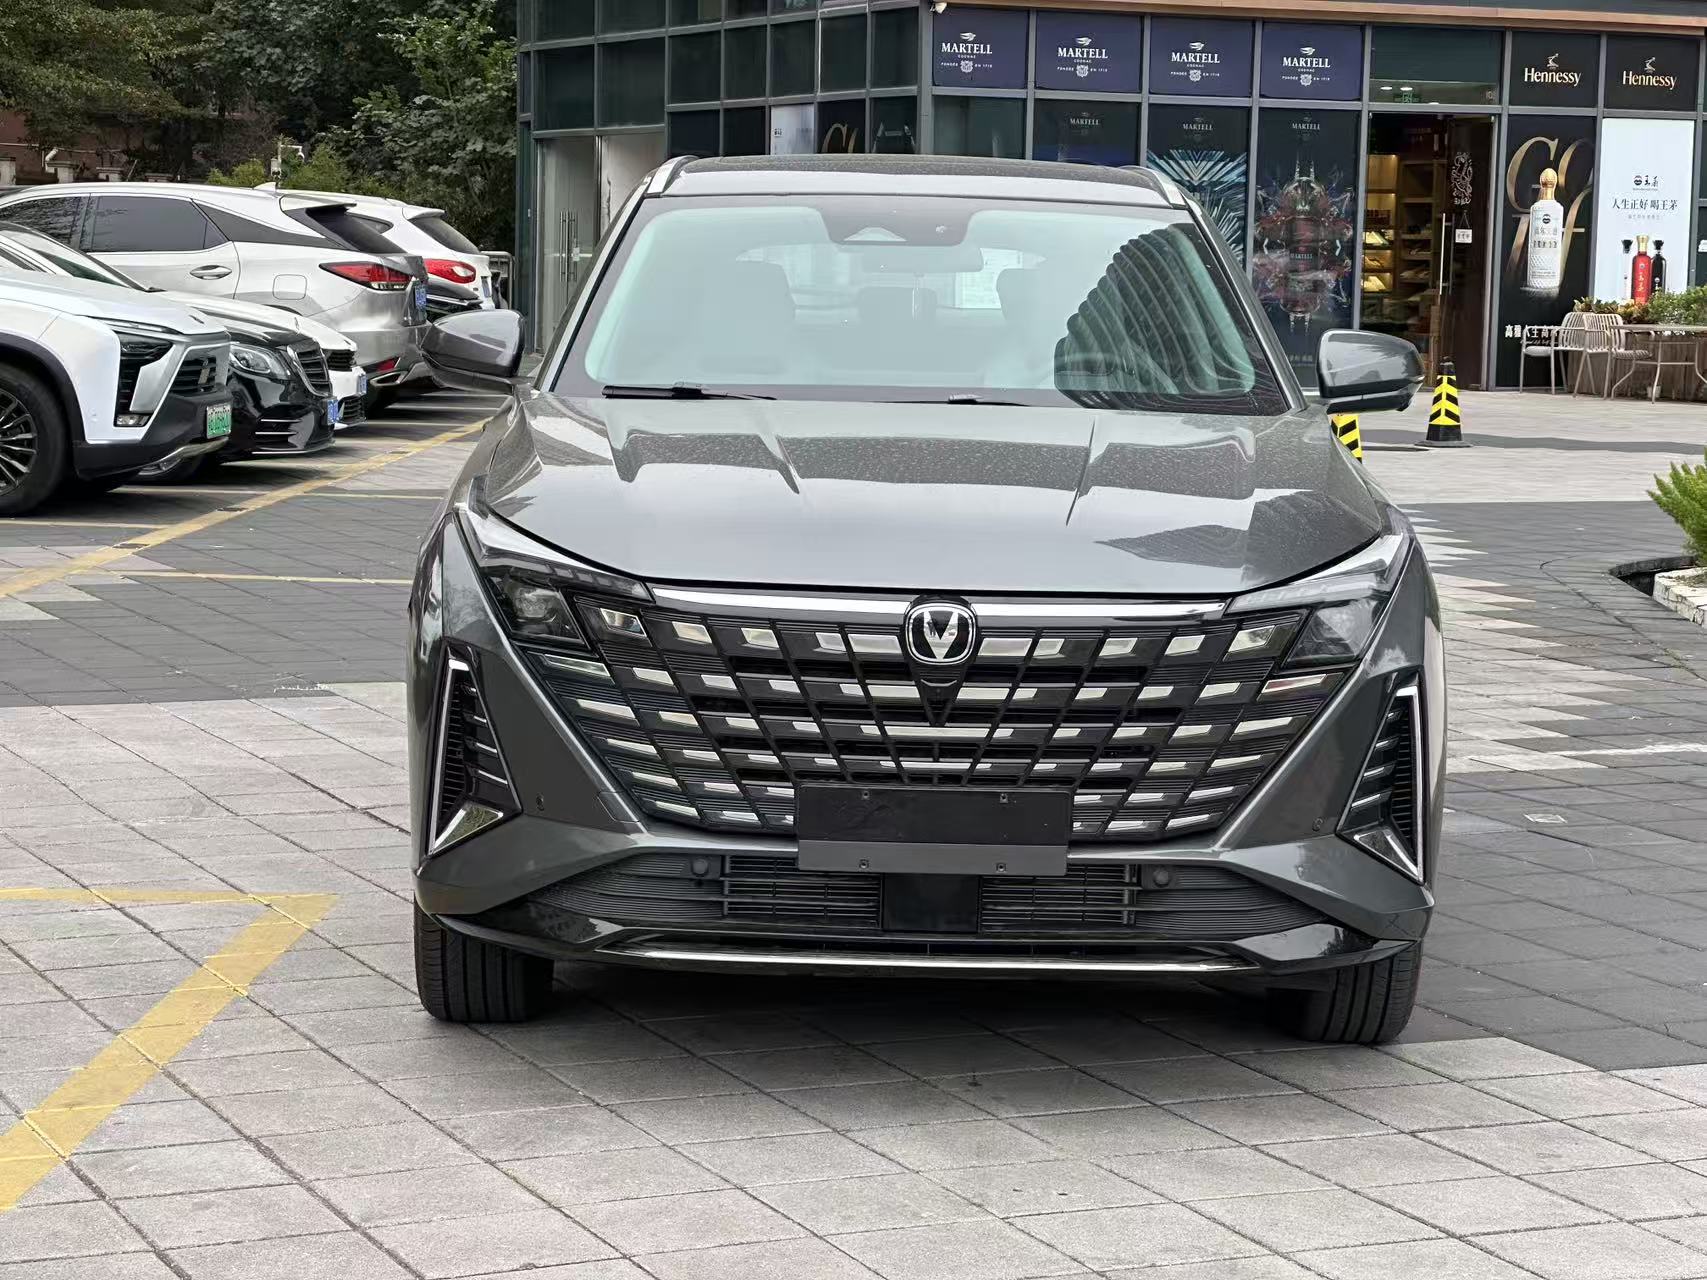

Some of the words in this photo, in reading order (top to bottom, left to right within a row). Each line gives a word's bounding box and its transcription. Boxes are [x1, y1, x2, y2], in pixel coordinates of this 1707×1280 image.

[941, 42, 993, 54] MARTELL
[1057, 47, 1108, 59] MARTELL
[1171, 51, 1220, 64] MARTELL
[1282, 56, 1331, 68] MARTELL
[1524, 67, 1582, 87] Hennessy
[1622, 70, 1678, 91] Hennessy
[1069, 118, 1099, 126] MARTELL
[1182, 123, 1213, 131] MARTELL
[1612, 198, 1648, 210] 人生正好
